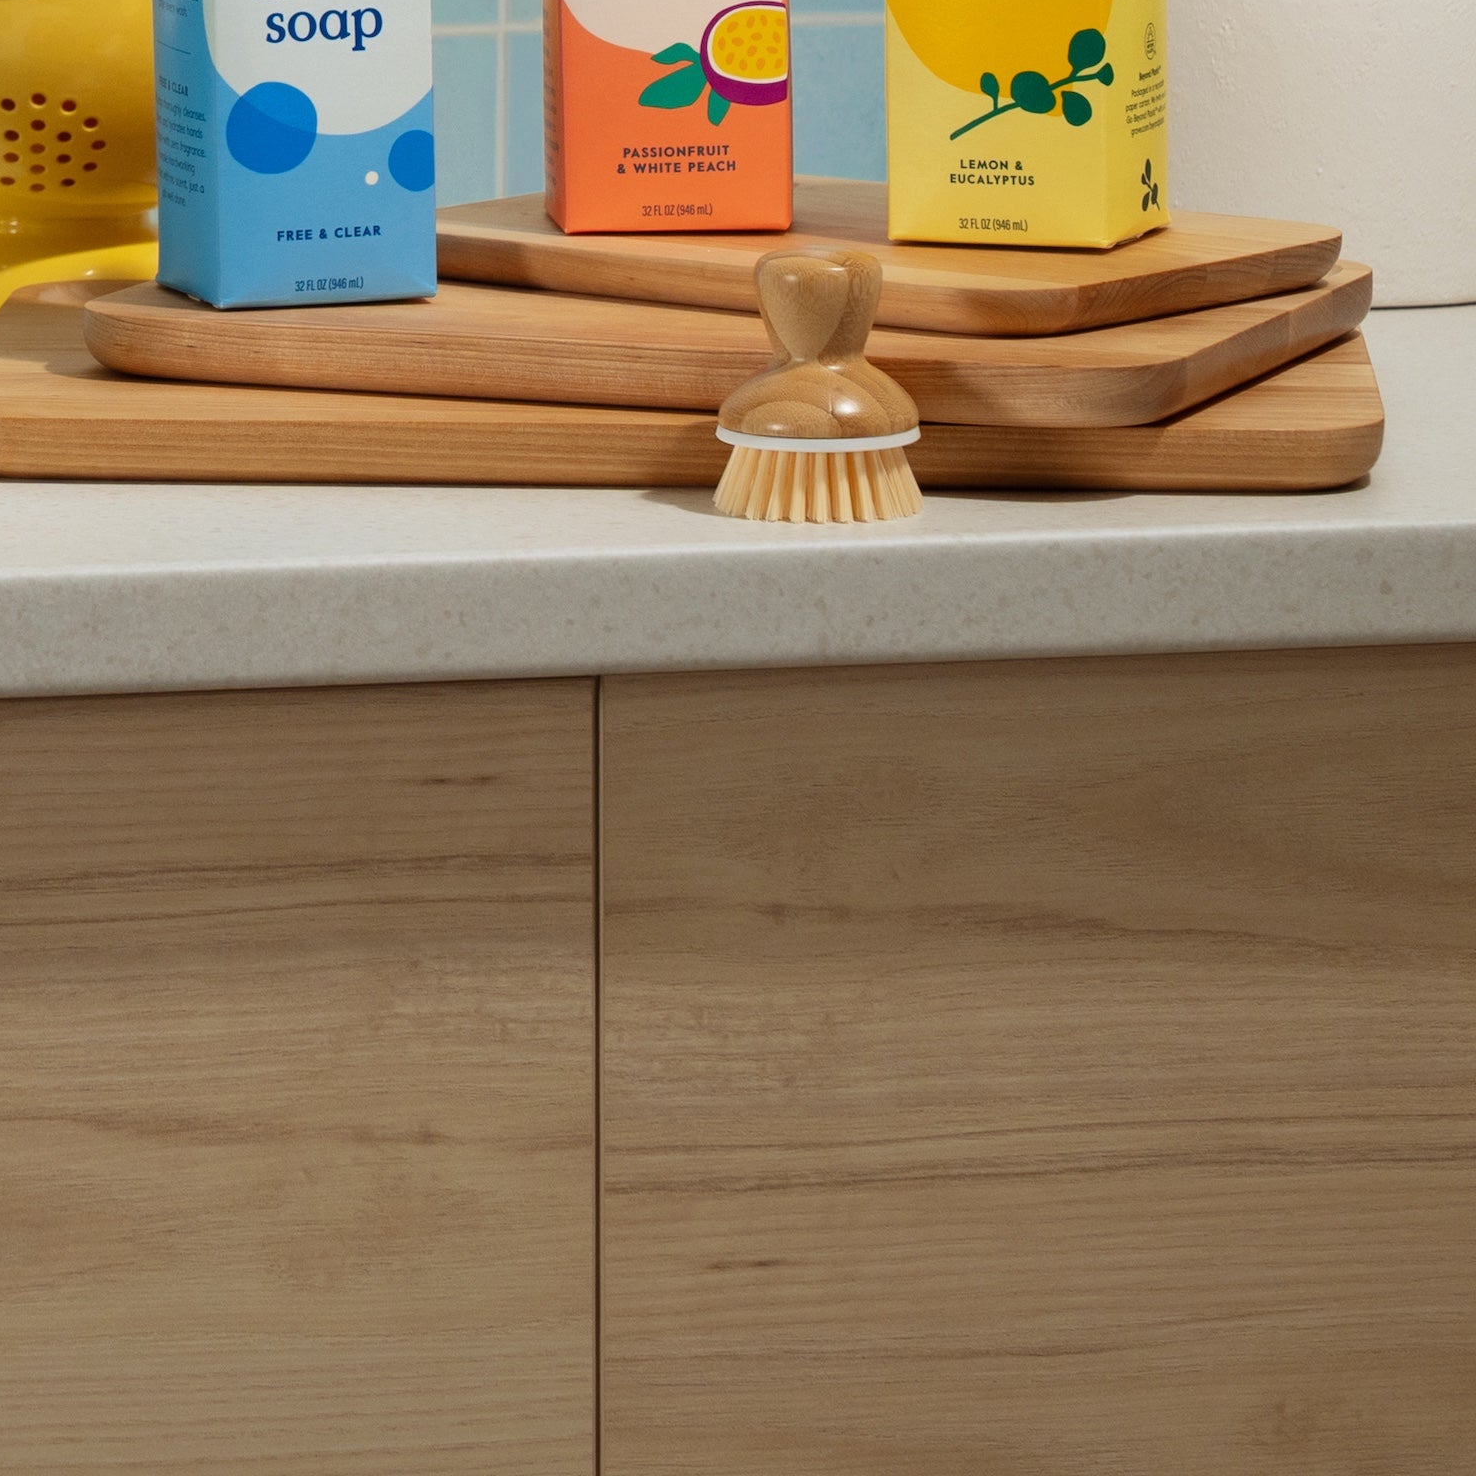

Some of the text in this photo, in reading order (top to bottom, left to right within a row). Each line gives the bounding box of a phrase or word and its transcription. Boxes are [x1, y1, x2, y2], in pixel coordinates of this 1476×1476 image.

[266, 7, 383, 52] soap
[623, 144, 730, 158] PASSIONFRUIT
[616, 160, 736, 175] & WHITE PEACH
[960, 159, 1023, 171] LEMON &
[949, 173, 1035, 186] EUCALYPTUS
[641, 203, 713, 217] 32 FL OZ (946 mL)
[958, 217, 1029, 233] 32 FL OZ (946 mL)
[277, 225, 381, 242] FREE & CLEAR
[294, 276, 364, 292] 32 FL OZ (946 mL)
